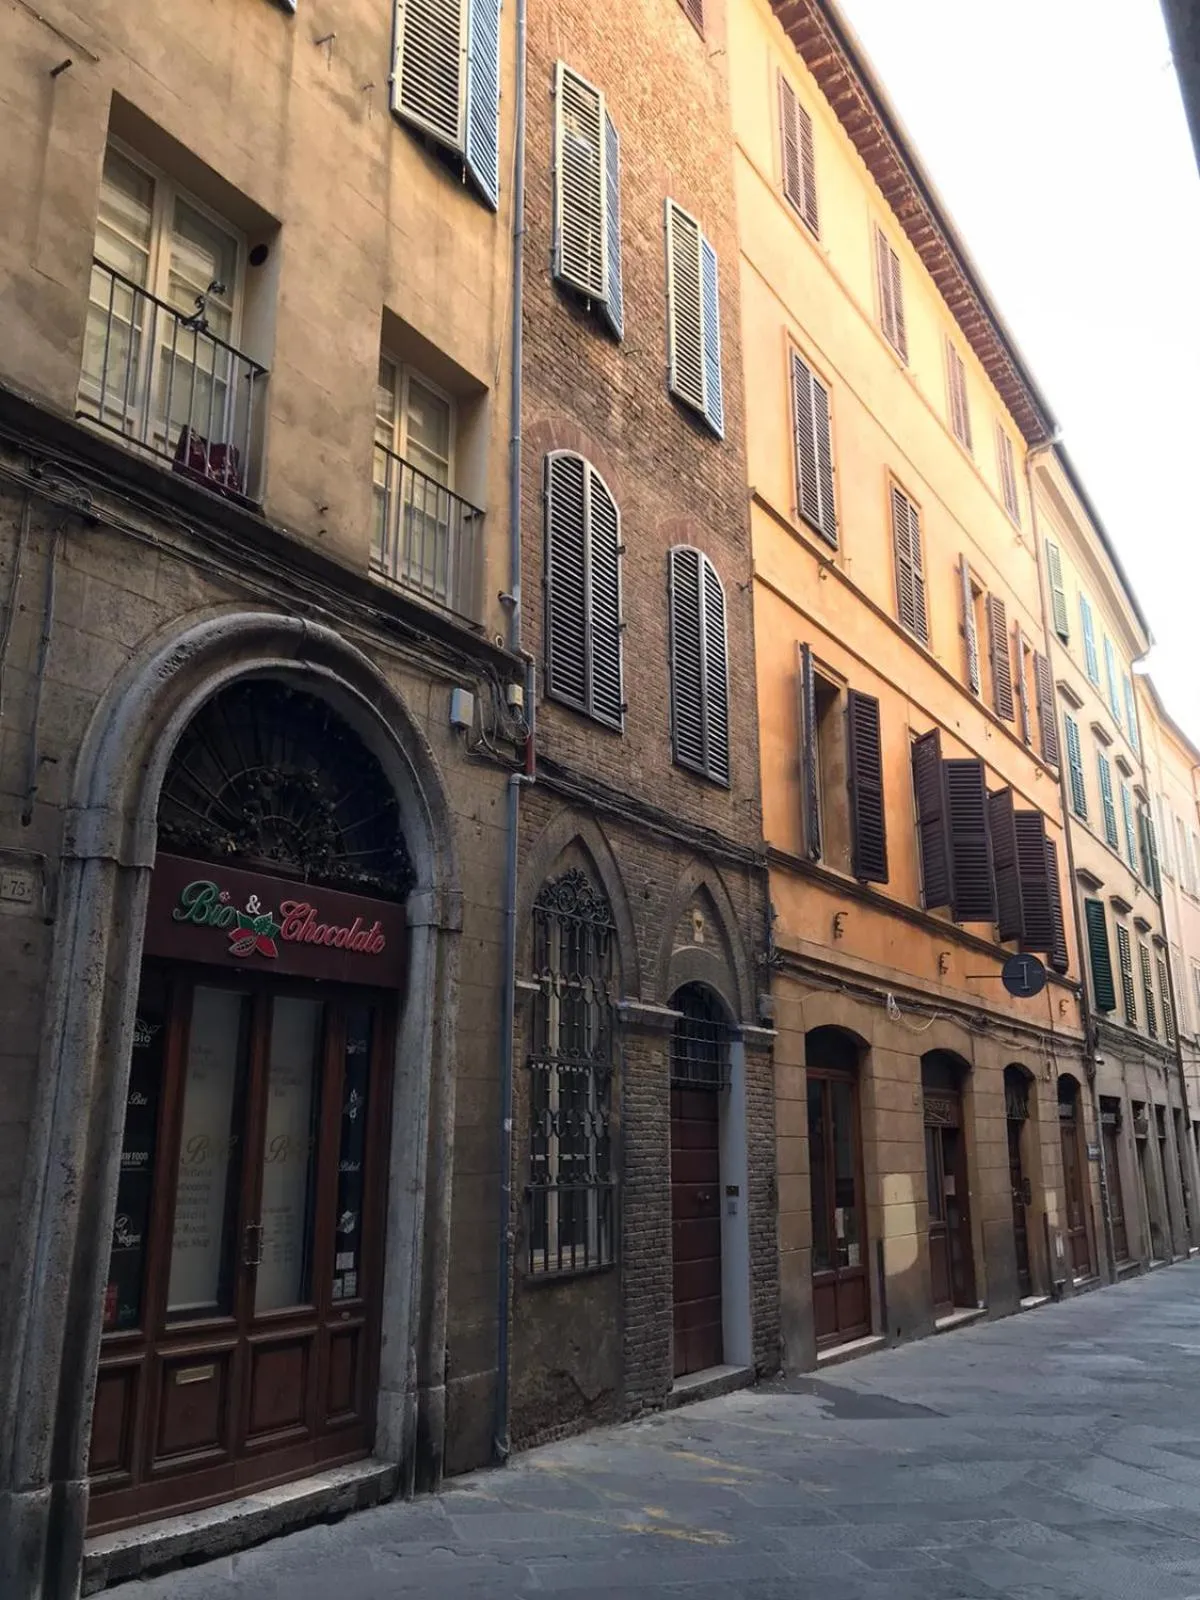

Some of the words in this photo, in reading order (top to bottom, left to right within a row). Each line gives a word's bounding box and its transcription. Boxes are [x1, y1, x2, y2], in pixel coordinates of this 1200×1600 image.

[11, 880, 25, 896] 75
[172, 880, 235, 927] Bio
[246, 894, 262, 915] &
[279, 899, 386, 955] Chocolate
